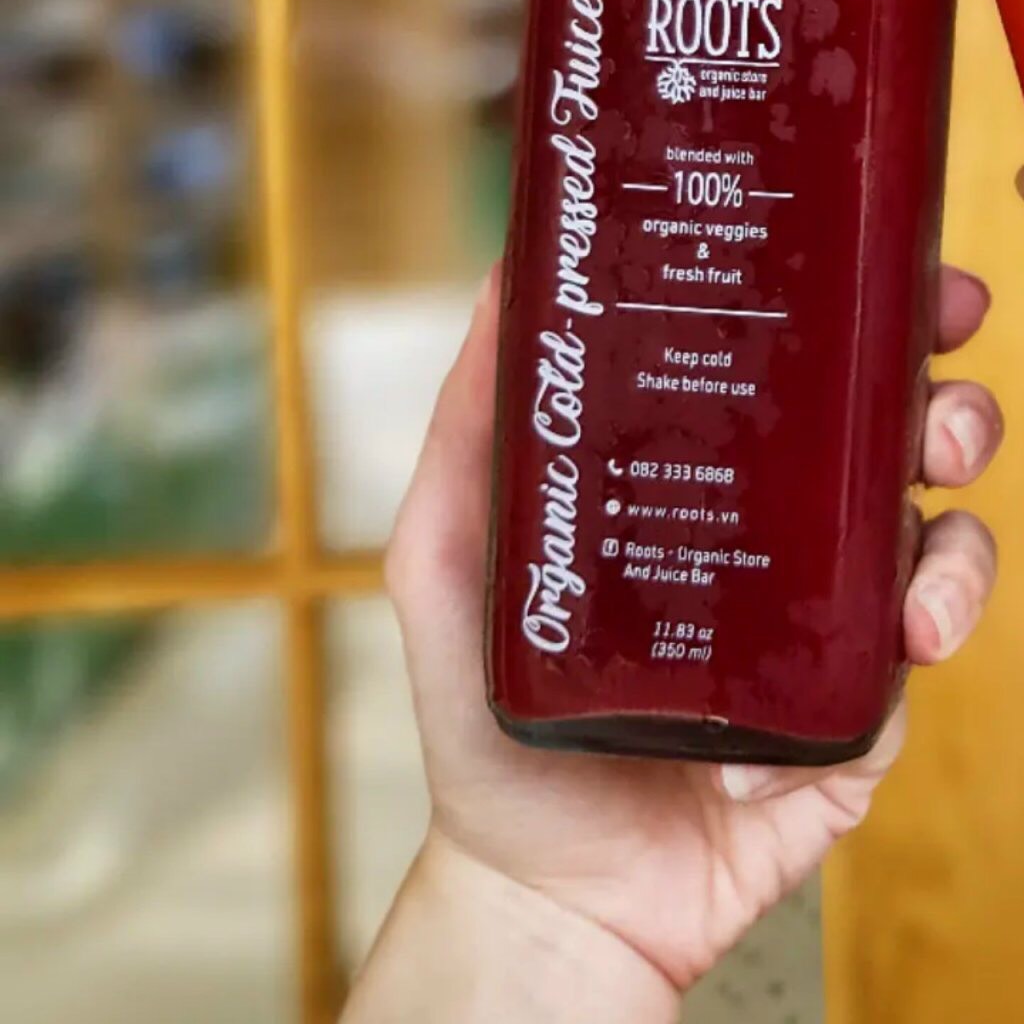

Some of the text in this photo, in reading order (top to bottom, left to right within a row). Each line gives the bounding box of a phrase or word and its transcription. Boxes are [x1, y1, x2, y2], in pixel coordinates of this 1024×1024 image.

[666, 146, 754, 165] blended with
[674, 171, 742, 208] 100%
[643, 218, 768, 241] organic veggies
[697, 242, 710, 259] &
[663, 264, 742, 285] fresh fruit
[664, 347, 732, 369] Keep cold
[637, 372, 756, 396] Shake before use
[630, 461, 735, 483] 082 333 6868
[627, 503, 739, 525] www.roots.vn
[522, 454, 586, 653] Organic
[625, 542, 665, 559] Roots
[678, 545, 730, 567] Organic
[733, 549, 771, 568] Store
[624, 565, 715, 585] And Juice Bar
[653, 621, 714, 639] 11.83 oz
[651, 641, 712, 661] (350 ml)
